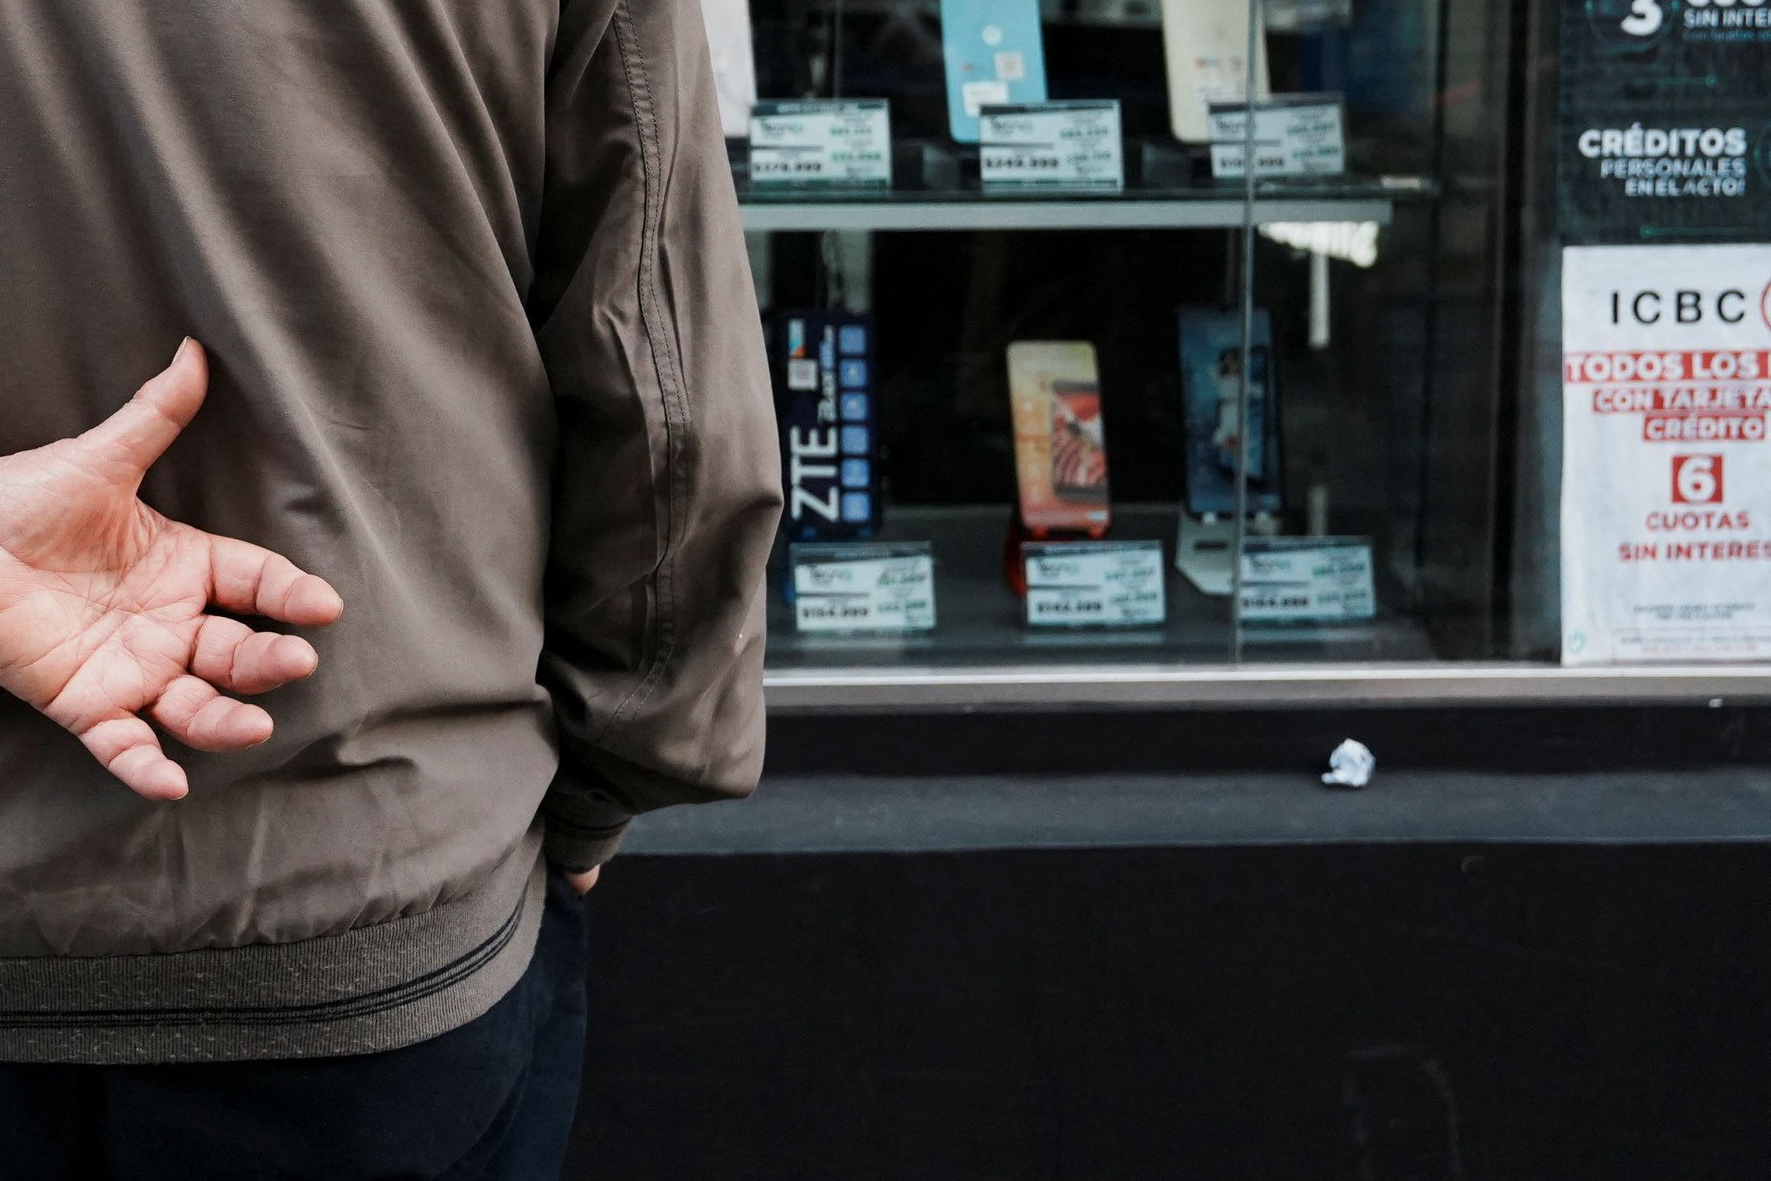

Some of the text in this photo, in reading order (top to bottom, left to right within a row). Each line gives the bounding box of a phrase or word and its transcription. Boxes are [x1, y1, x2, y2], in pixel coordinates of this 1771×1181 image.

[1683, 8, 1771, 29] SIN INTE
[1578, 122, 1747, 159] CRÉDITOS
[1600, 158, 1747, 179] PERSONALES
[1625, 177, 1654, 196] EN
[1655, 177, 1680, 196] EL
[1610, 290, 1747, 324] ICBC
[1564, 351, 1760, 382] TODOS LOS
[1595, 387, 1654, 411] CON
[1647, 411, 1764, 439] CRÉDITO
[789, 425, 840, 523] ZTE
[1676, 456, 1716, 504] 6
[1645, 510, 1750, 532] CUOTAS
[1618, 542, 1658, 562] SIN
